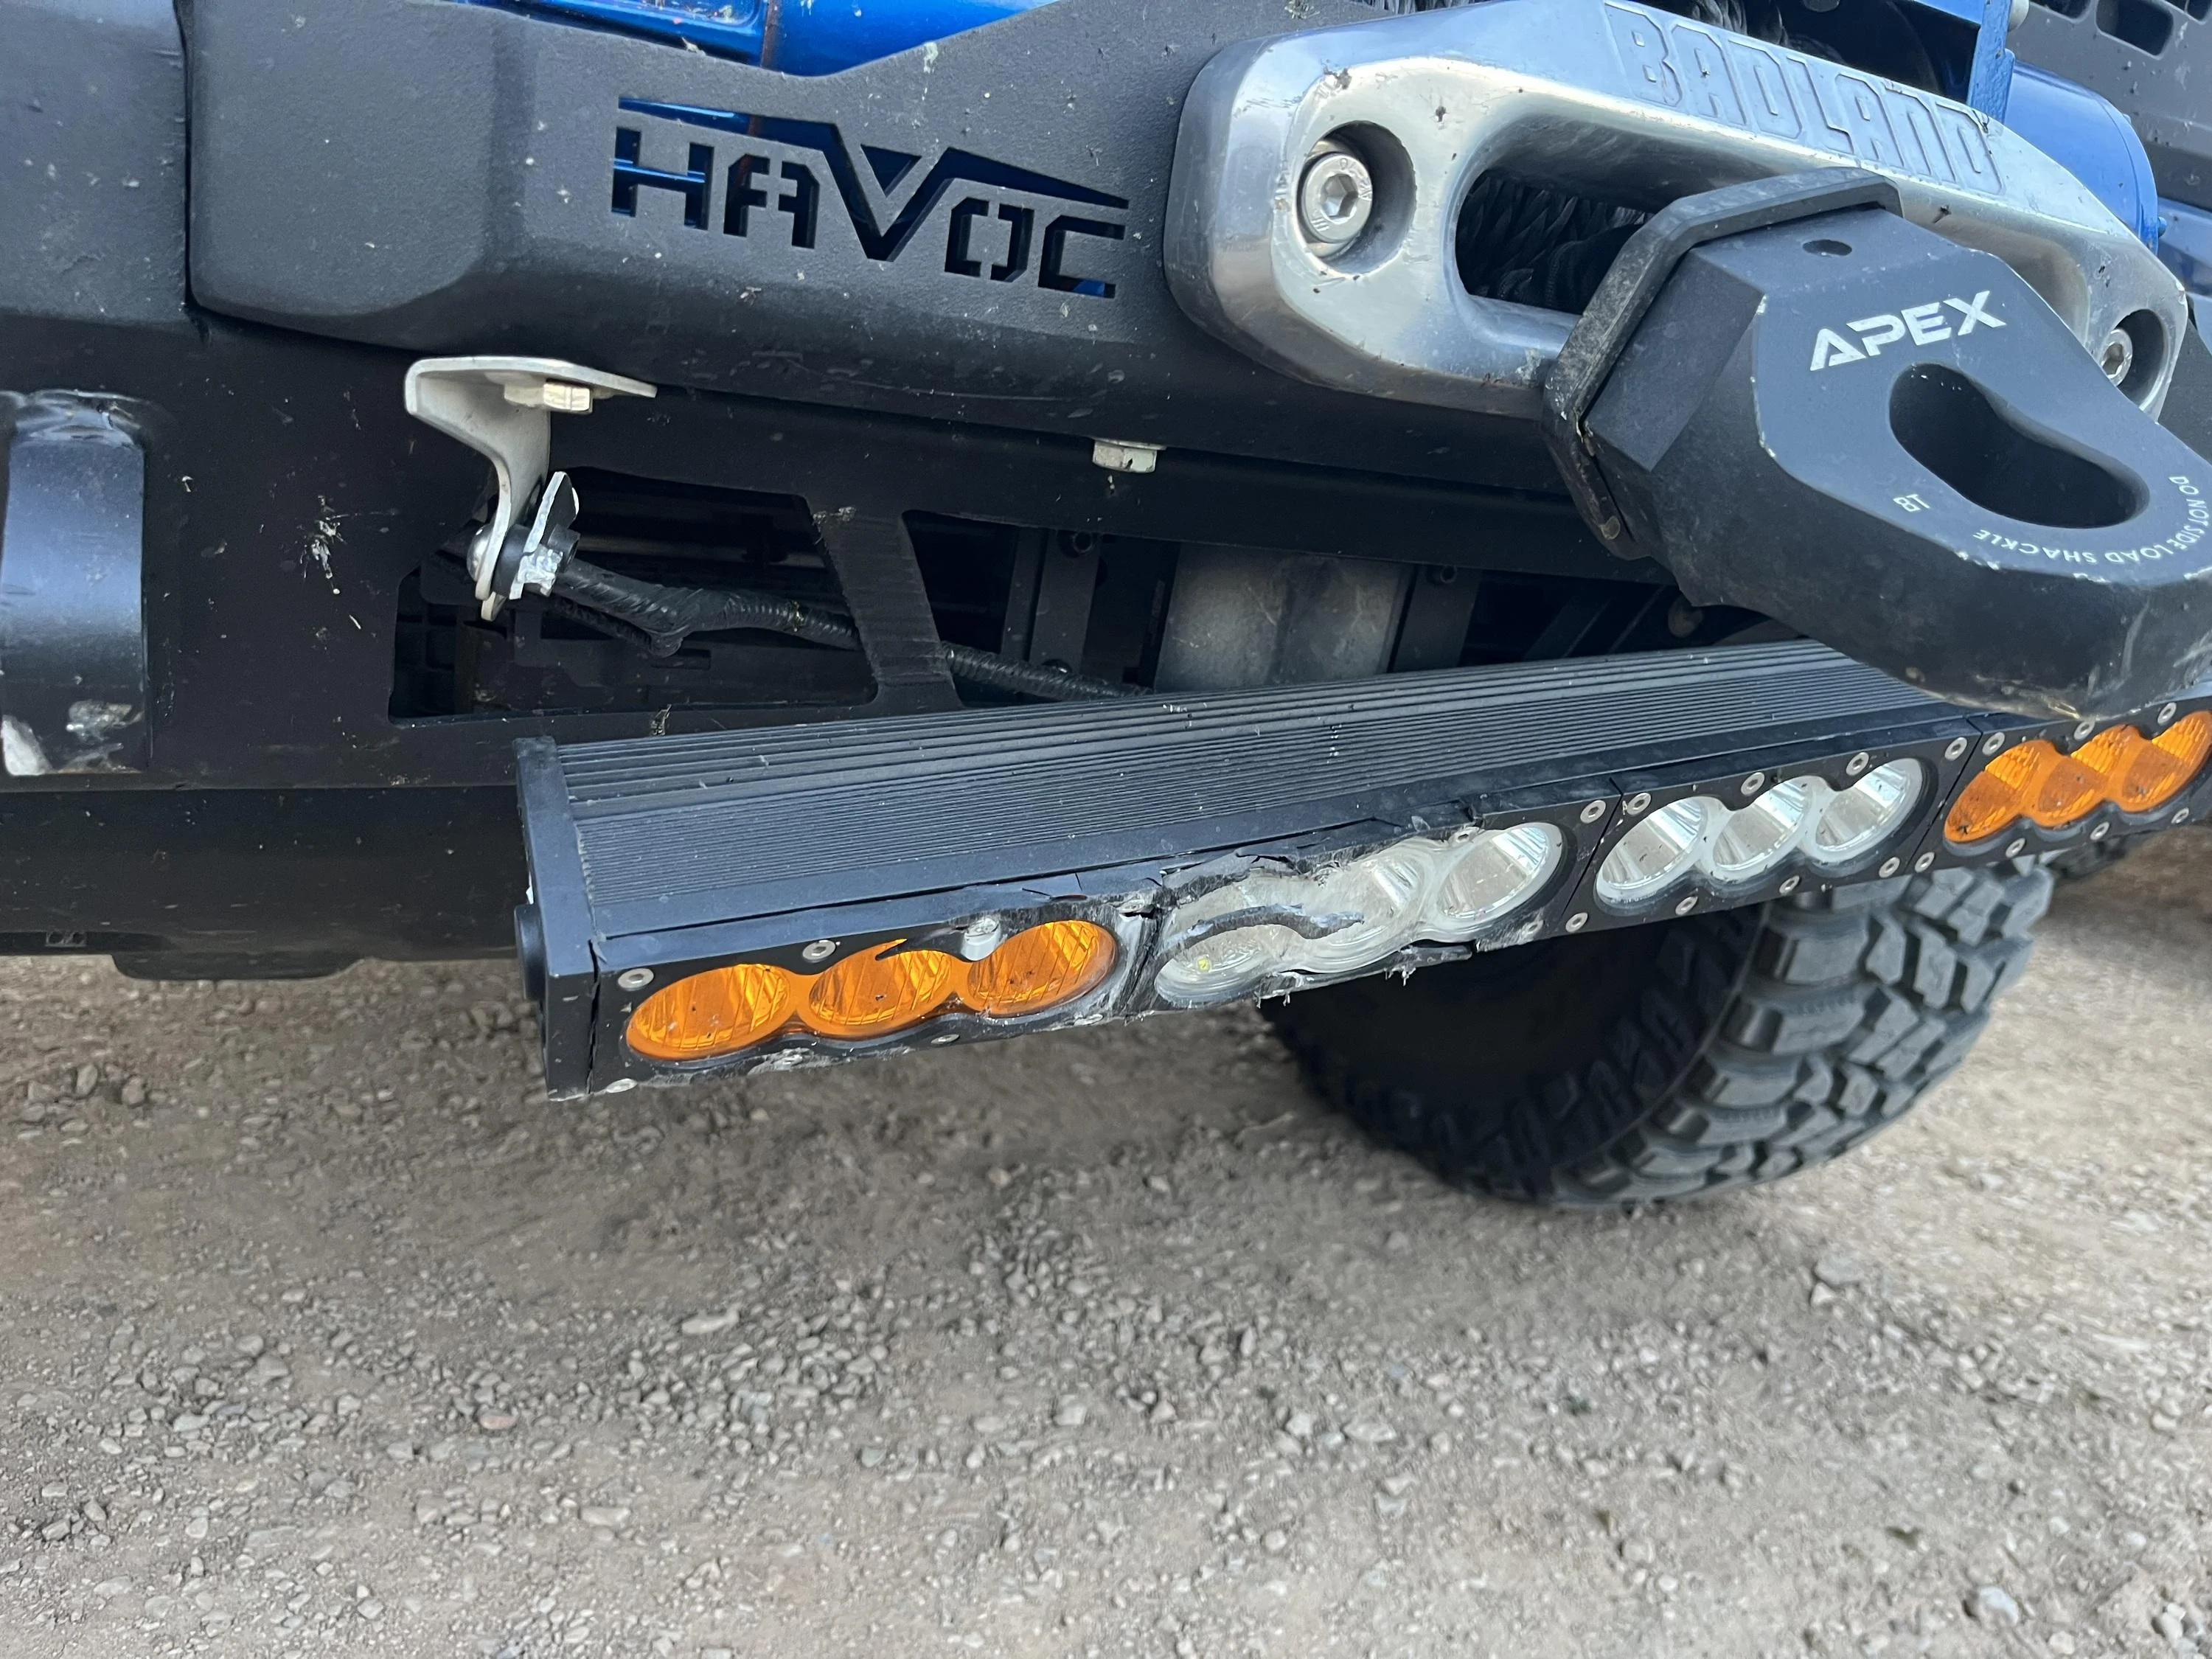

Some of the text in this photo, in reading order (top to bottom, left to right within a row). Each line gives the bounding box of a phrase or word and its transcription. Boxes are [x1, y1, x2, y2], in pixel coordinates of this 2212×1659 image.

[1607, 2, 2006, 195] BADLAND
[611, 97, 1129, 299] HAVOC
[1809, 290, 2007, 371] APEX
[1972, 476, 2210, 564] DO NOT SIDE LOAD SHACKLE
